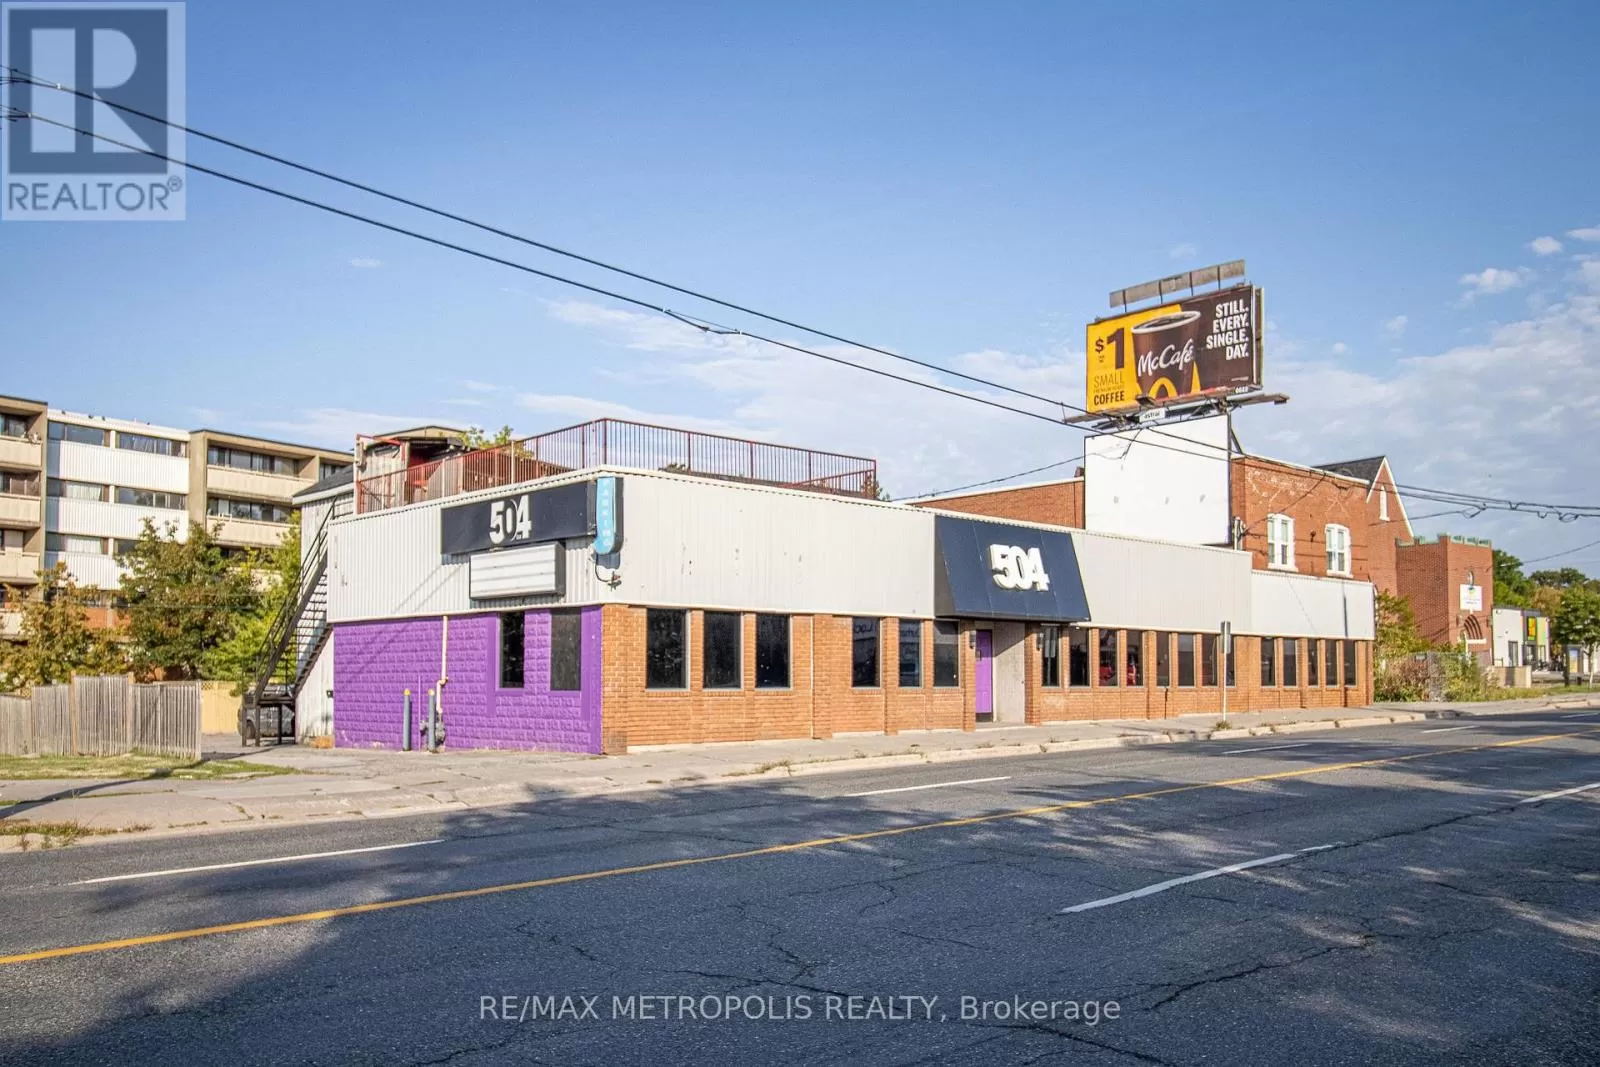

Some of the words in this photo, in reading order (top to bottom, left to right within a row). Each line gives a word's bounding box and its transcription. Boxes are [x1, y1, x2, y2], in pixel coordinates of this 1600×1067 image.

[1215, 299, 1249, 319] STILL.
[1212, 313, 1249, 334] EVERY.
[1206, 328, 1249, 350] SINGLE.
[1225, 343, 1249, 361] DAY.
[1093, 371, 1125, 389] SMALL
[1093, 390, 1125, 406] COFFEE
[489, 494, 532, 544] 504
[989, 543, 1050, 592] 504
